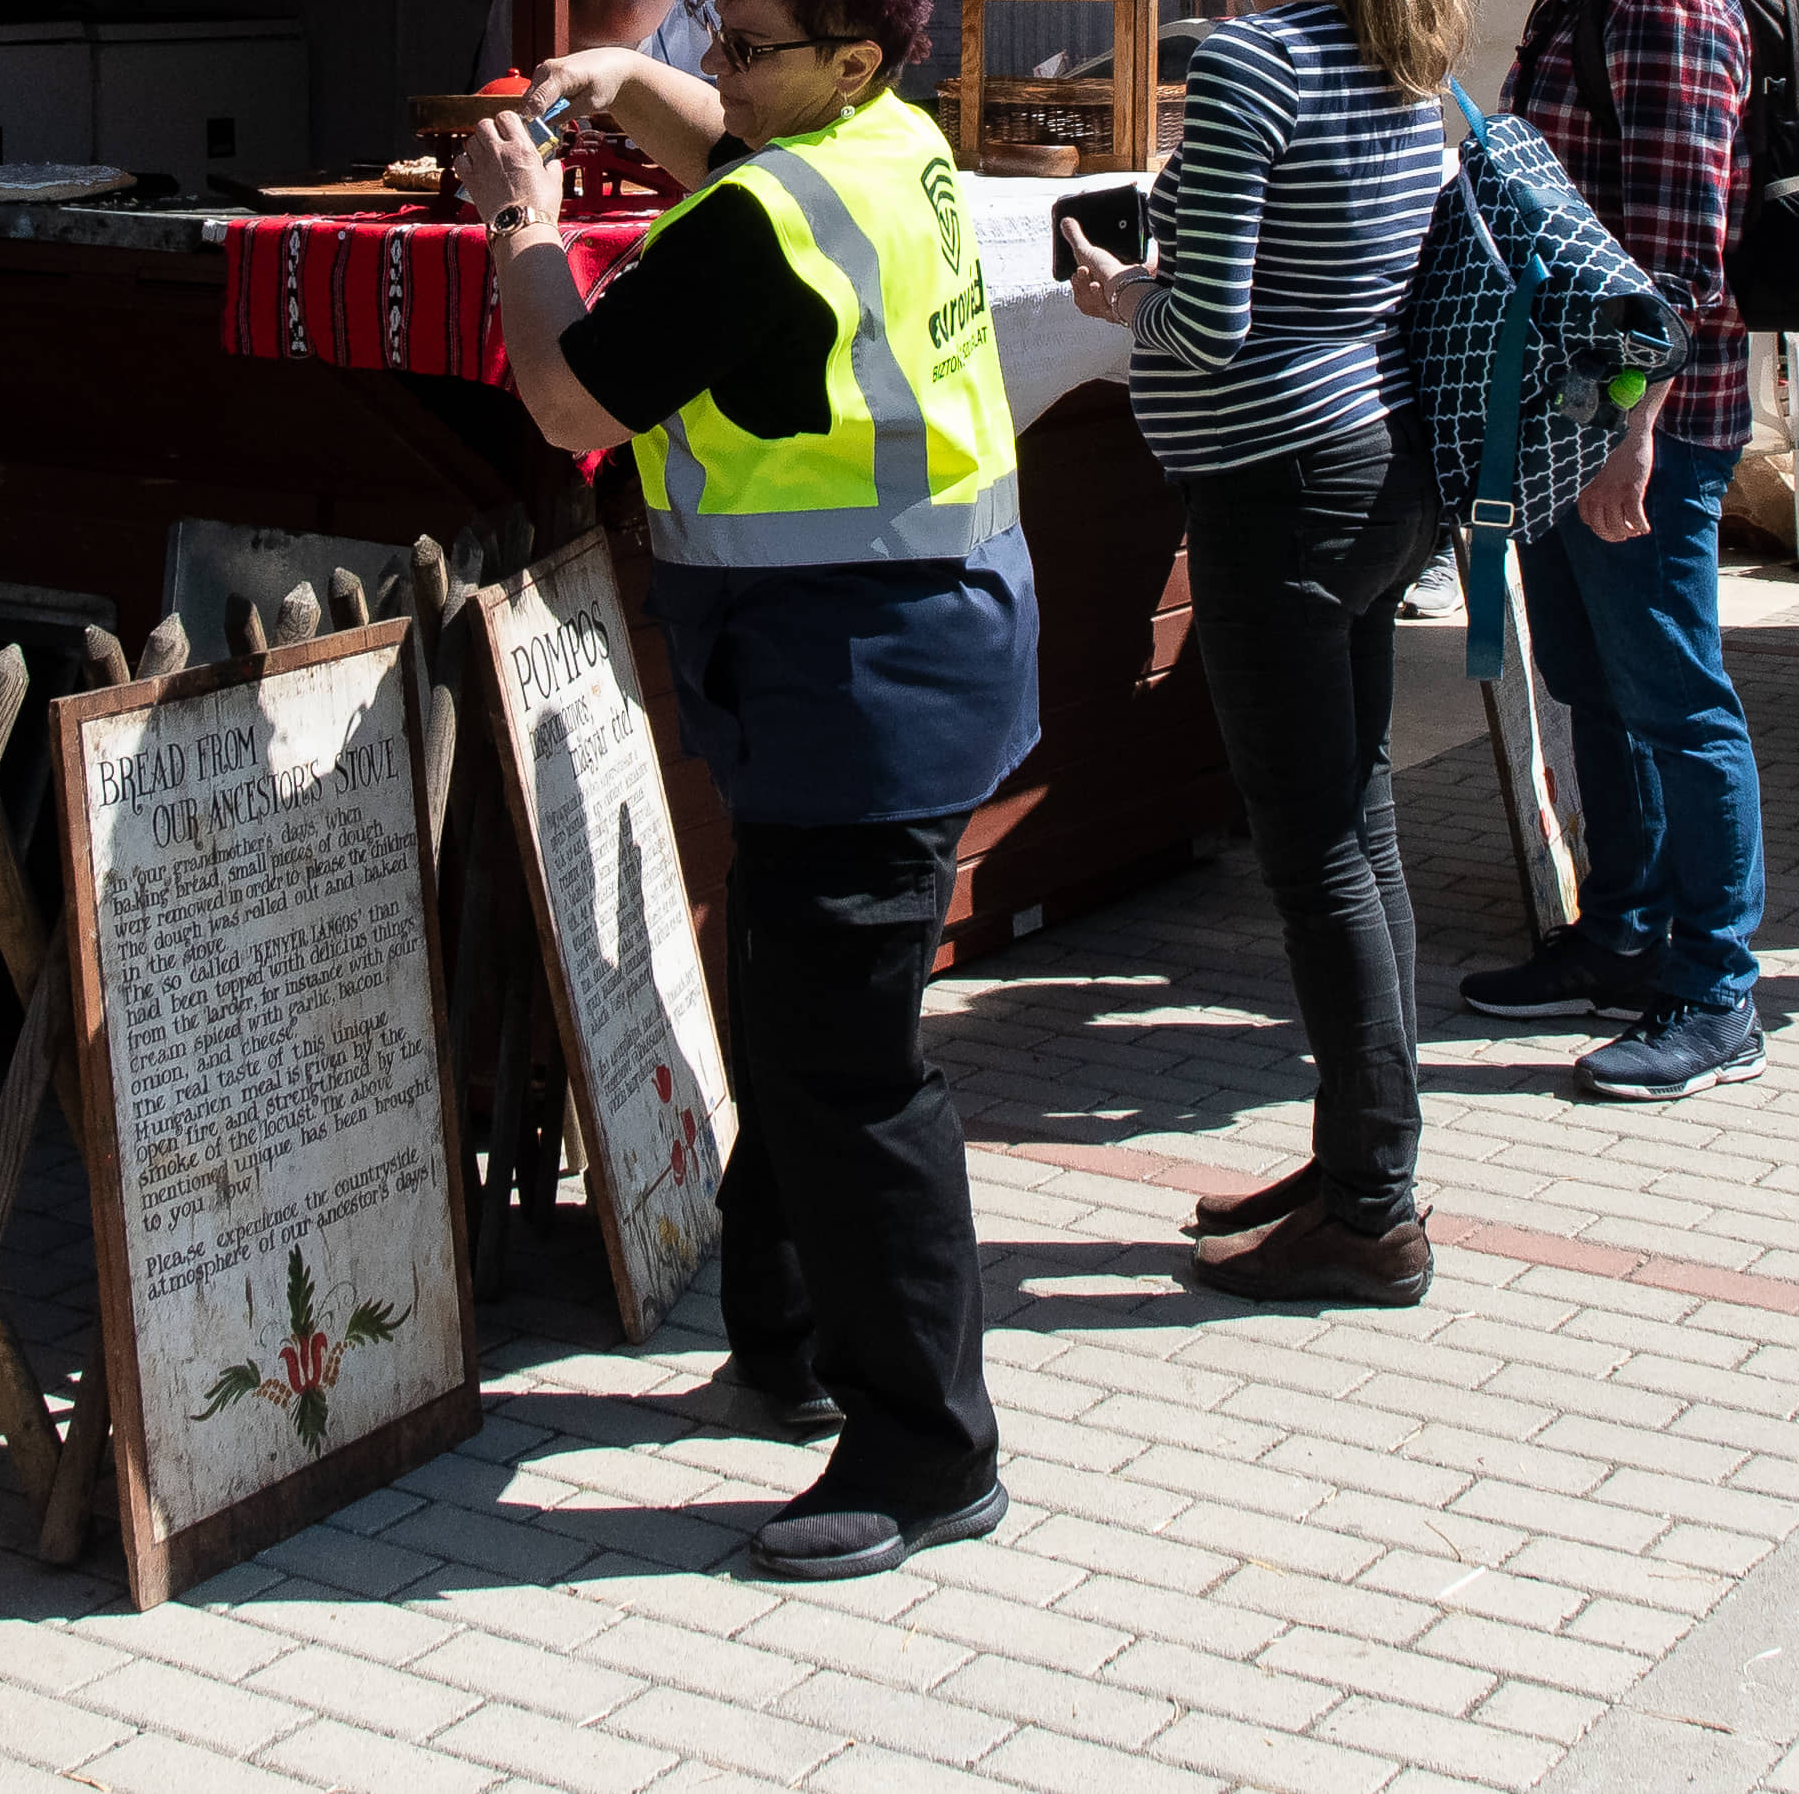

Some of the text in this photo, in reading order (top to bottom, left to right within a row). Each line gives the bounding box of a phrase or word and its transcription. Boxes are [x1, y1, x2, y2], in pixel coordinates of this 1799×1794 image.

[511, 600, 610, 712] POMPOS
[98, 725, 257, 815] BREAD FROM
[151, 797, 203, 851] OUR
[333, 737, 399, 796] STOVE
